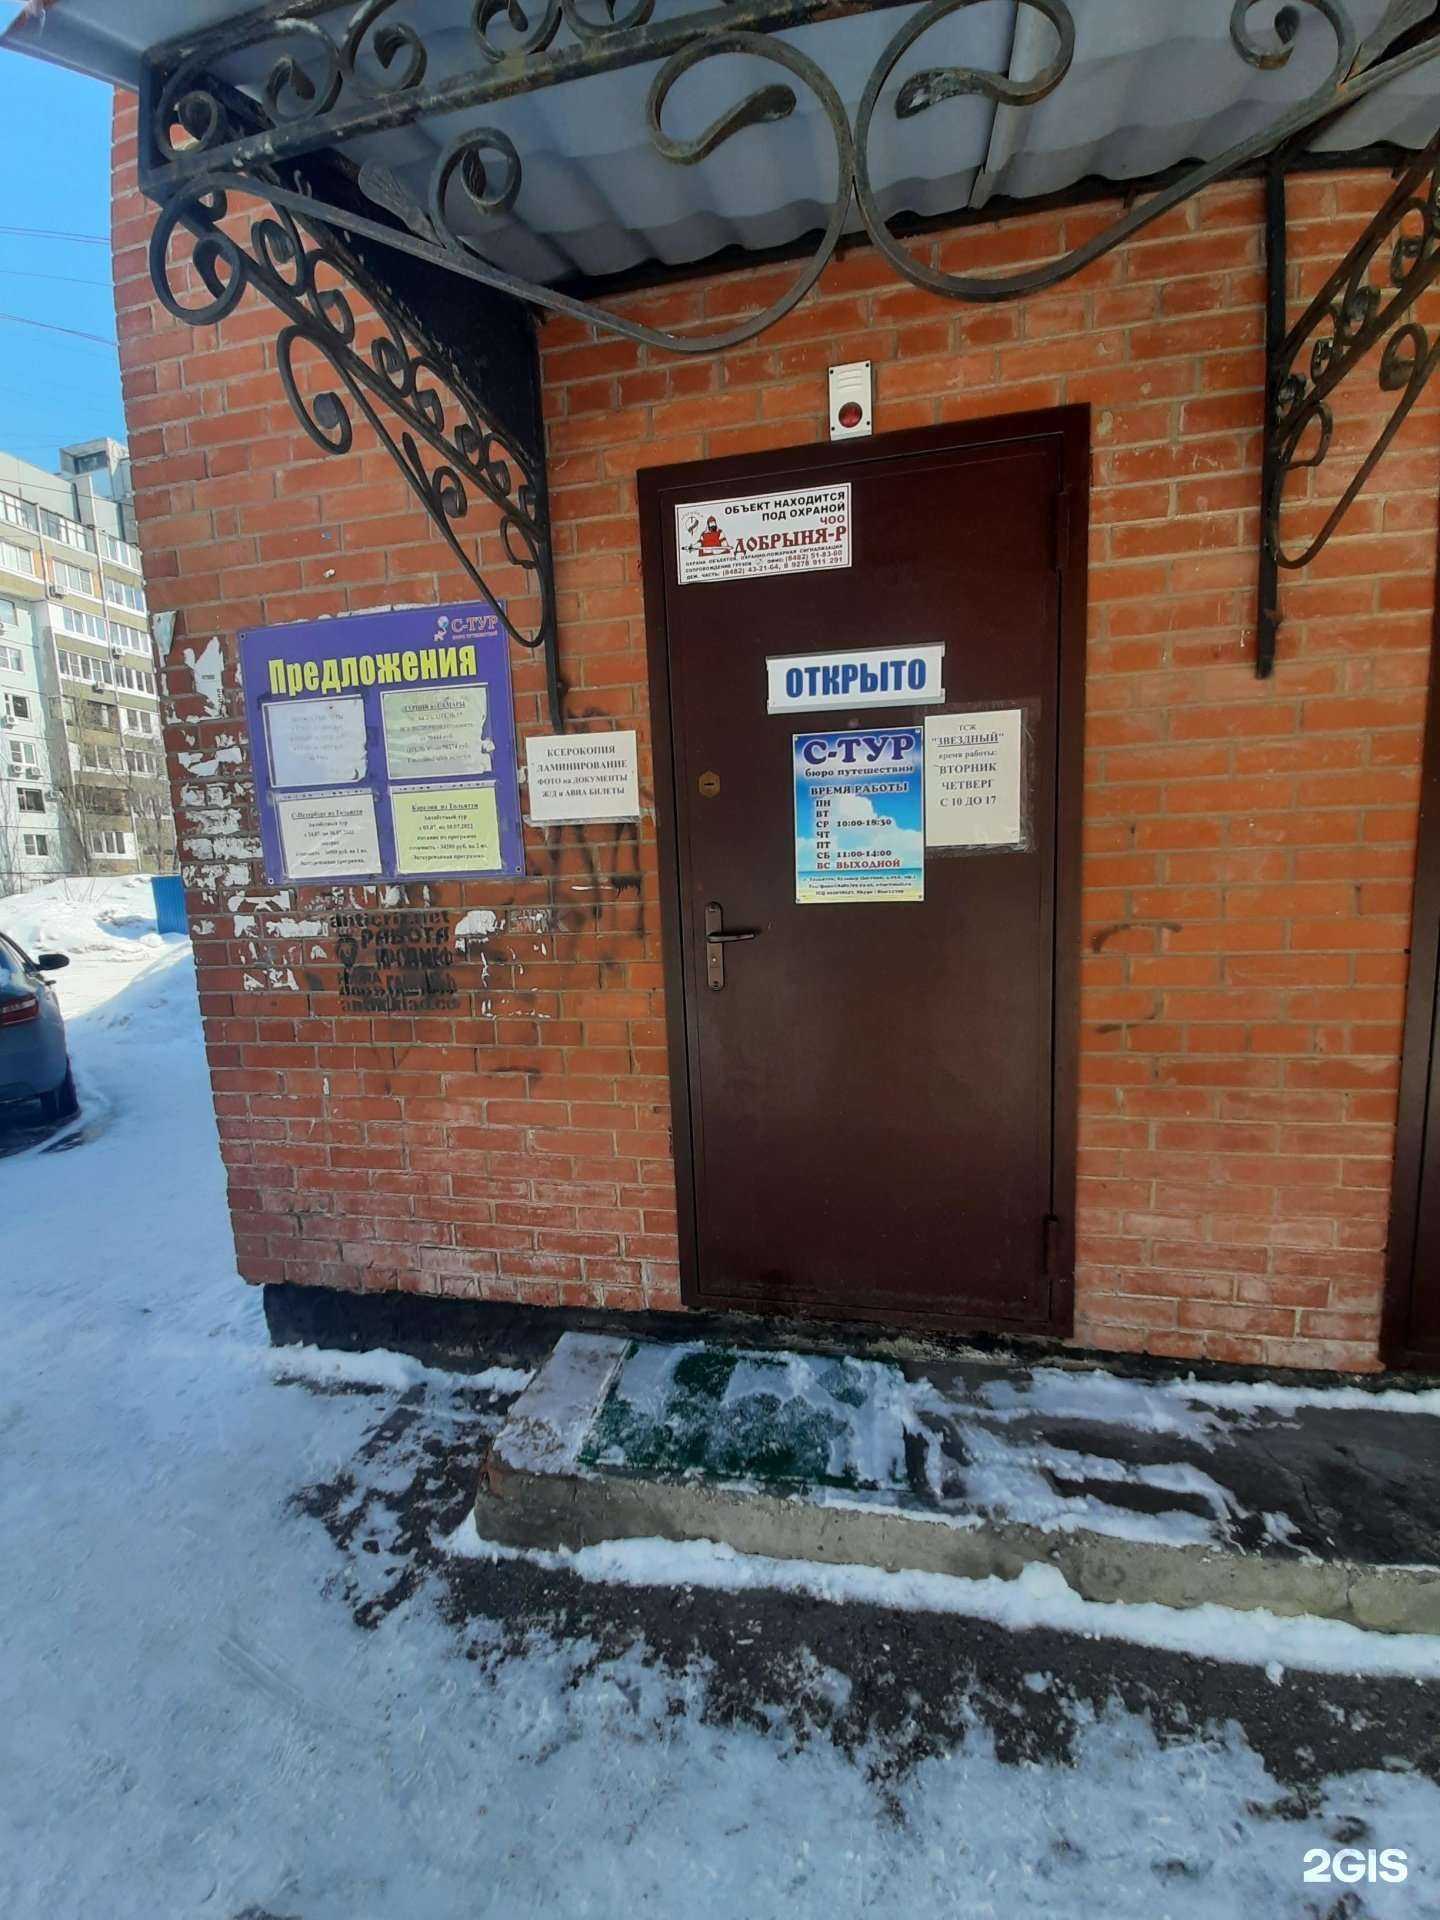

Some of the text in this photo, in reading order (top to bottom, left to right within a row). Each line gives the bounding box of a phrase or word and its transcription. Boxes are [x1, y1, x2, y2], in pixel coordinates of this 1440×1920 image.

[725, 491, 845, 515] ОБЪЕКТ НАХОДИТСЯ
[762, 502, 845, 522] ПОД ОХРАНОЙ
[820, 515, 845, 526] ЧОО
[734, 526, 847, 556] ДОБРЫНЯ-Р
[451, 615, 498, 633] С-ТУР
[268, 645, 477, 696] Предложения
[786, 658, 927, 698] ОТКРЫТО
[547, 744, 616, 758] КСЕРОКОПИЯ
[803, 734, 915, 765] С-ТУР
[537, 760, 628, 773] ЛАМИНИРОВАНИЕ
[805, 765, 914, 778] бюро путешествий
[939, 762, 997, 776] ВТОРНИК
[537, 777, 562, 786] ФОТО
[573, 774, 628, 784] ДОКУМЕНТЫ
[942, 779, 994, 791] ЧЕТВЕРГ
[589, 787, 625, 796] БИЛЕТЫ
[811, 782, 908, 796] ВРЕМЯ РАБОТЫ
[816, 800, 831, 808] ПН
[952, 797, 963, 807] 10
[965, 796, 983, 807] ДО
[986, 795, 997, 805] 17
[816, 810, 829, 818] ВТ
[816, 820, 829, 828] СР
[817, 831, 831, 839] ЧТ
[816, 841, 831, 849] ПТ
[817, 849, 892, 860] СБ 11:00-14:00
[817, 858, 901, 870] ВС ВЫХОДНОЙ
